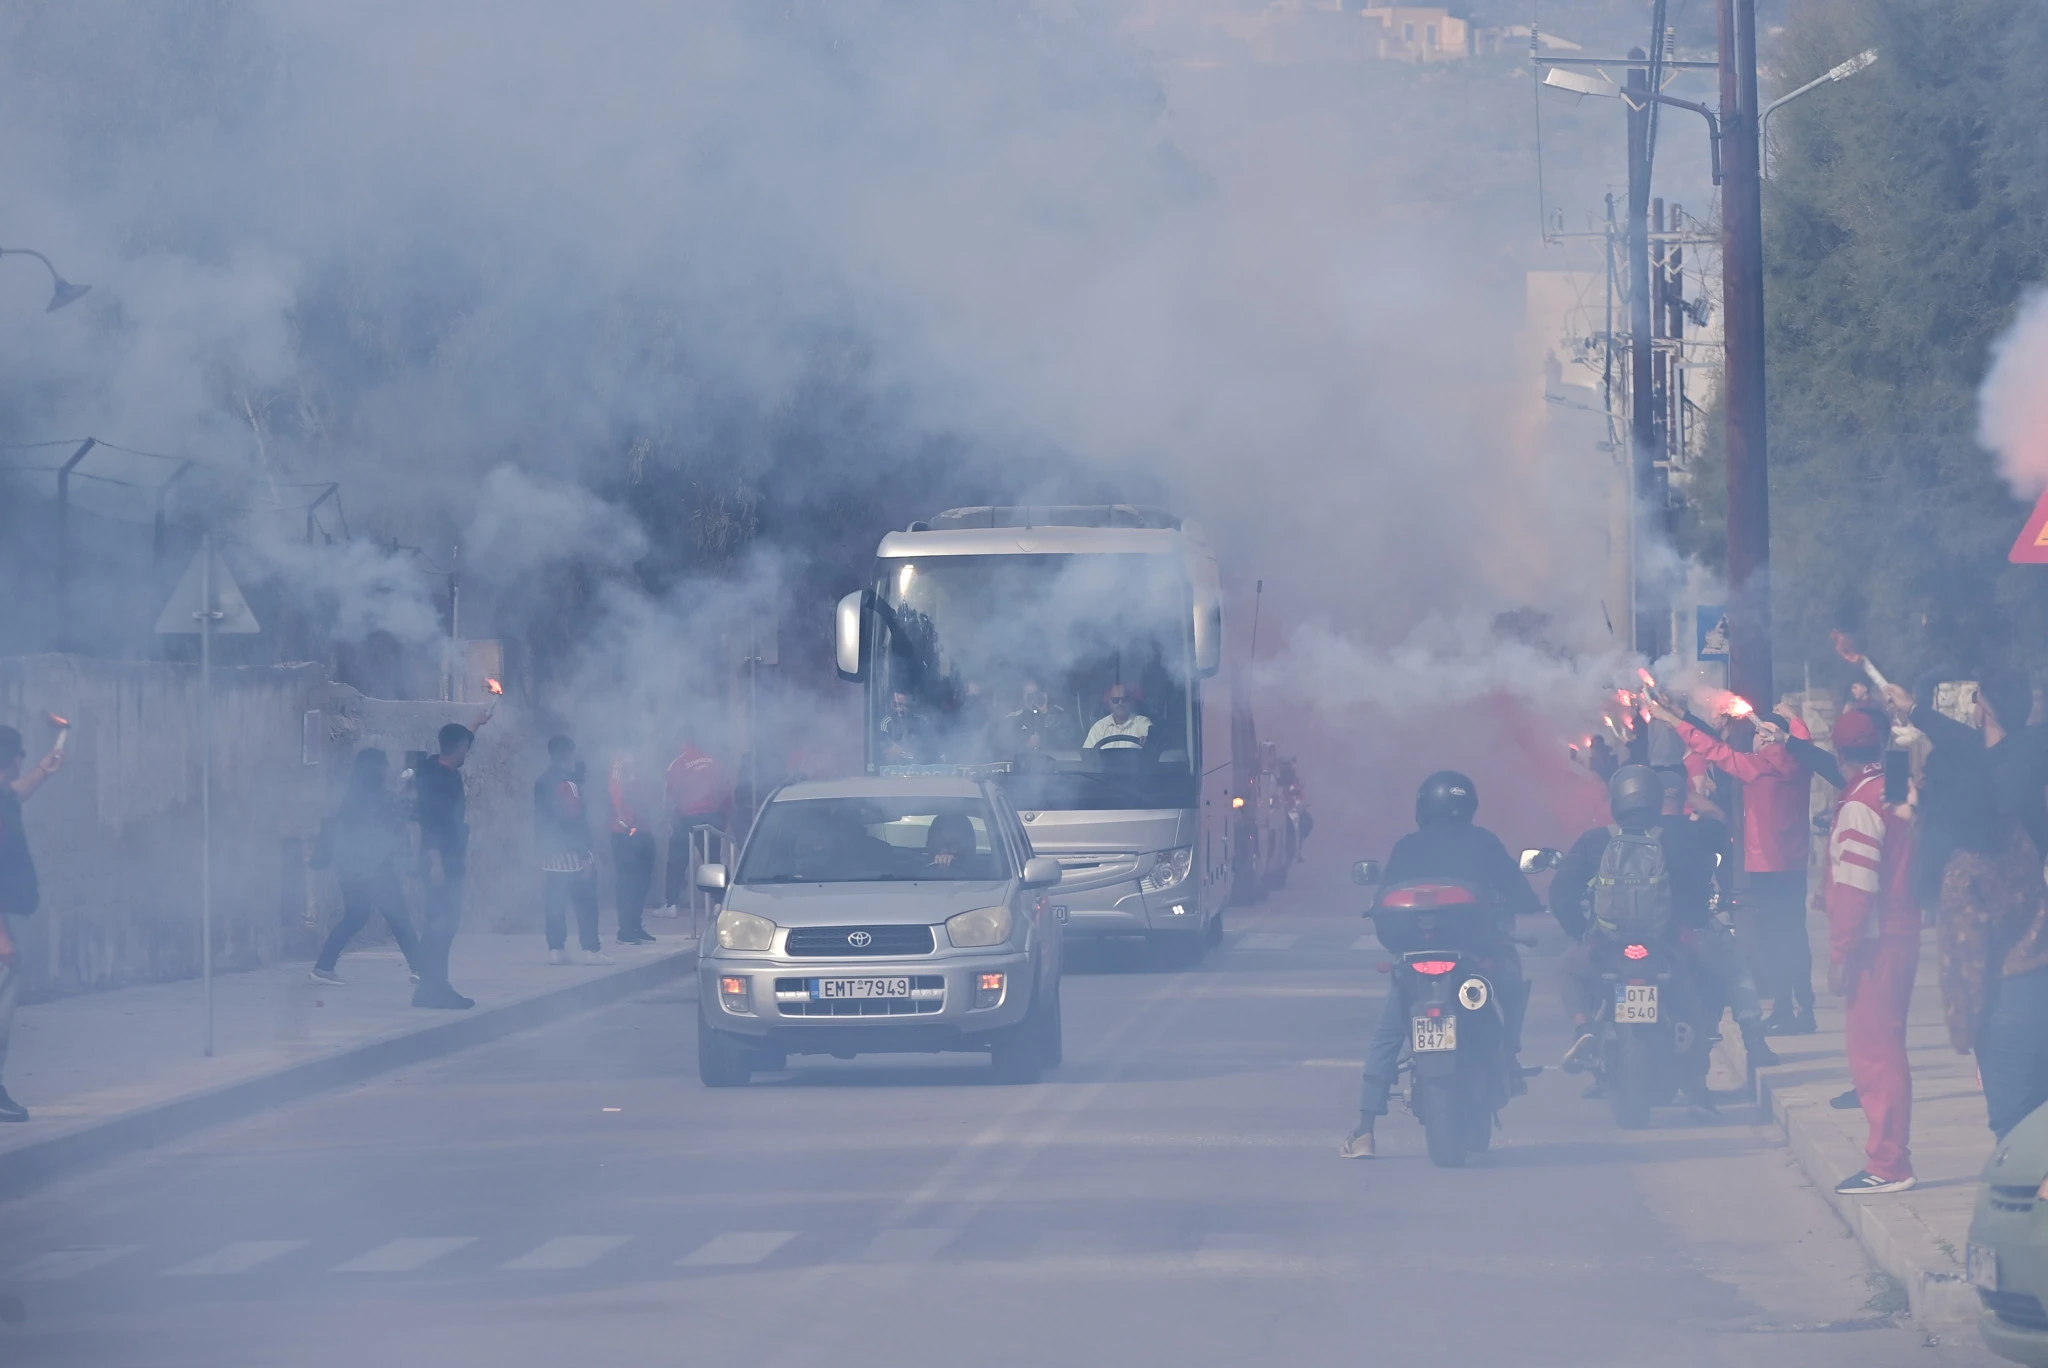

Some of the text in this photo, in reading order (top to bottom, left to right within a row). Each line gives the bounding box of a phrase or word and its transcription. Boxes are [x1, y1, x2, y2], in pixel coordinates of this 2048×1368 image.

[1627, 989, 1656, 1002] OTA
[1627, 1006, 1656, 1019] 540
[1417, 1034, 1444, 1049] 847
